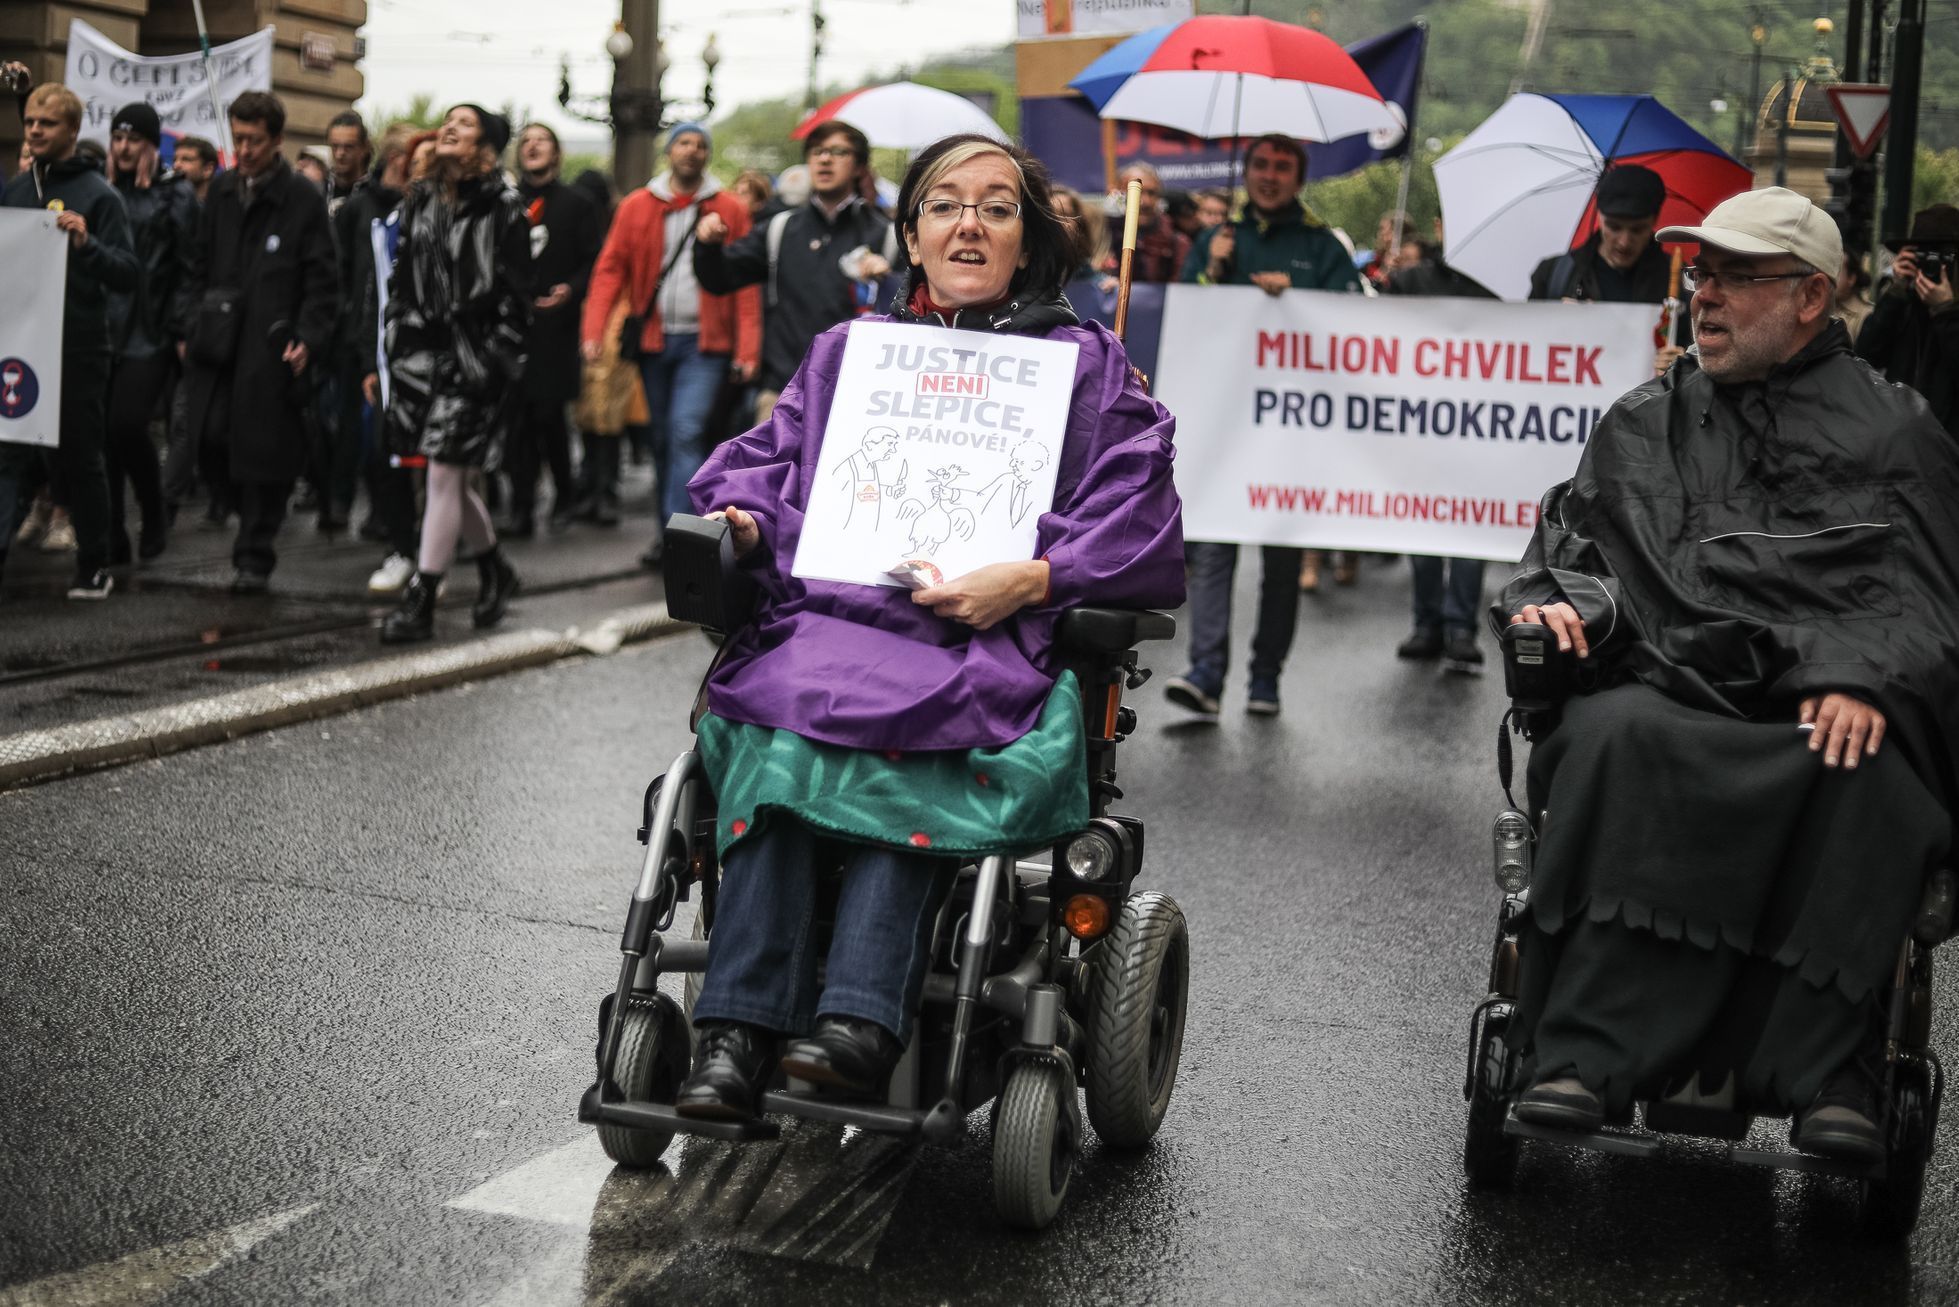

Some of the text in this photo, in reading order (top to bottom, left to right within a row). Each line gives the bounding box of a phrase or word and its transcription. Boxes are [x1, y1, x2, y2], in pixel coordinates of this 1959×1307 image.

[78, 51, 98, 80] O
[875, 344, 1041, 387] JUSTICE
[1256, 330, 1604, 385] MILION CHVILEK
[921, 374, 984, 395] NENÍ
[865, 390, 1034, 438] SLEPICE,
[1255, 389, 1333, 428] PRO
[905, 424, 1008, 453] PÁNOVÉ!
[1248, 485, 1541, 528] WWW.MILIONCHVILE
